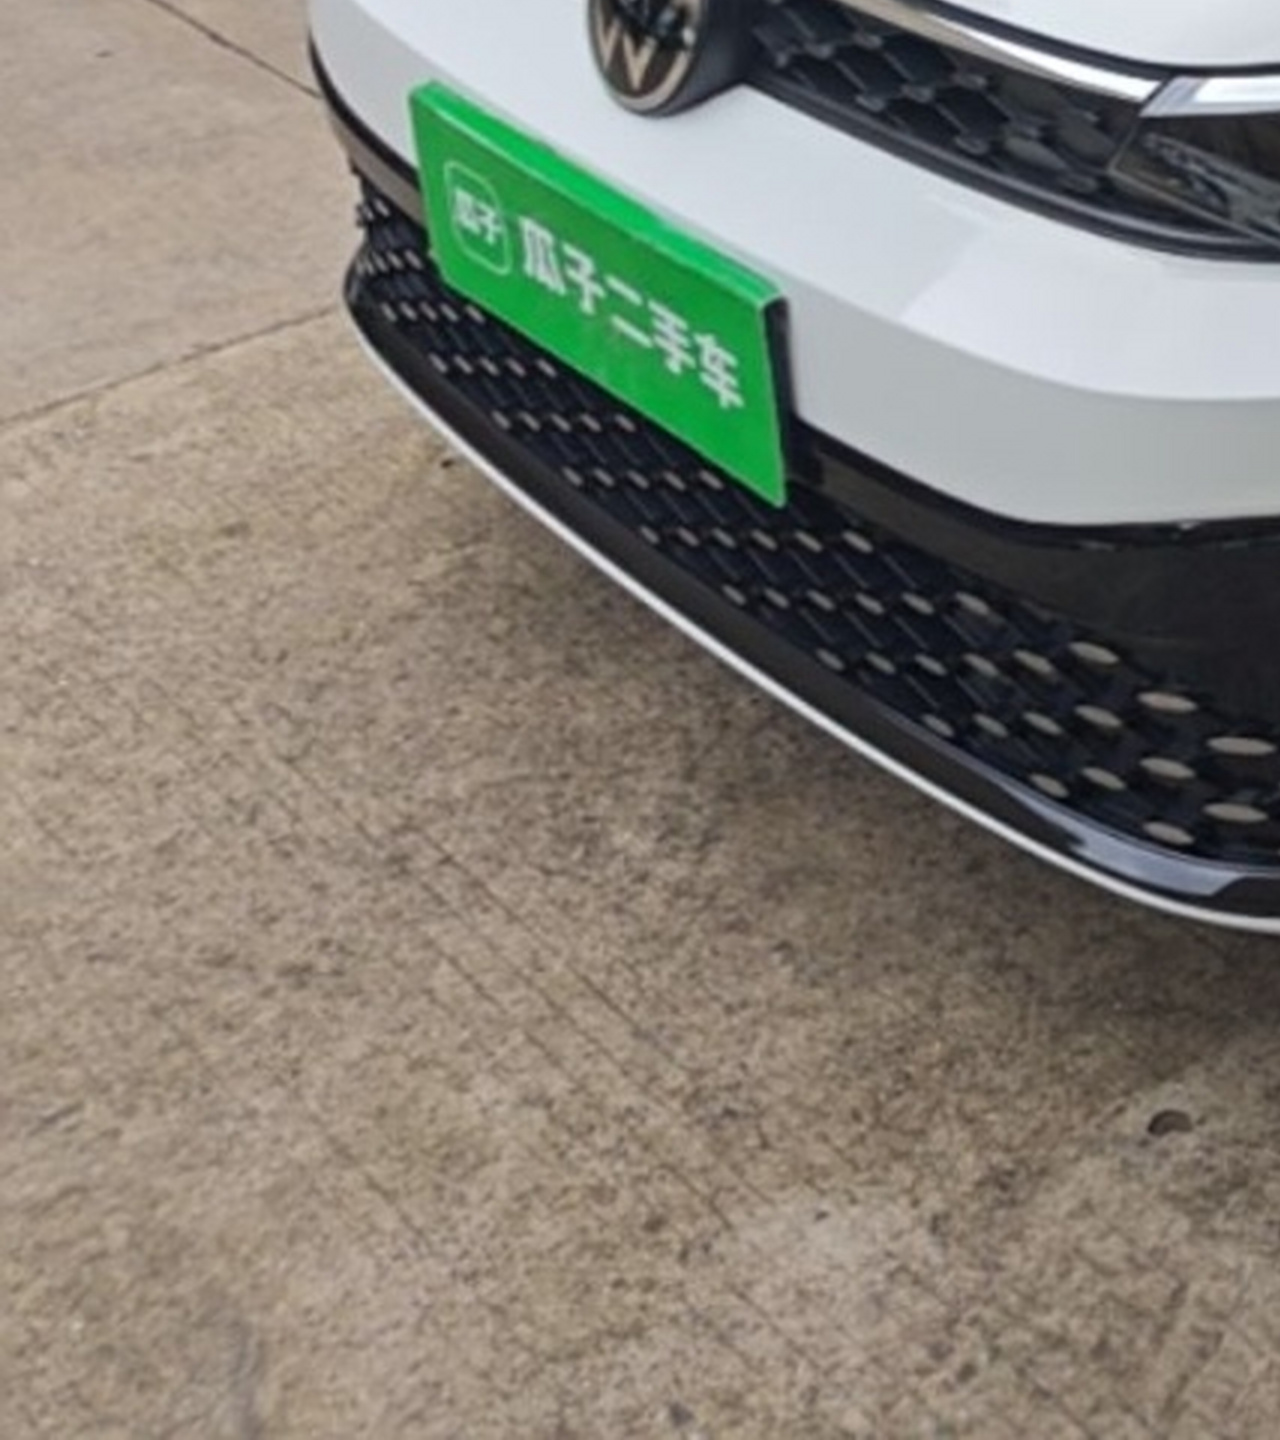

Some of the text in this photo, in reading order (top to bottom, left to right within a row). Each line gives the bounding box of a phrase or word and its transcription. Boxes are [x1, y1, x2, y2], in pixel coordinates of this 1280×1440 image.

[518, 215, 744, 411] 瓜子二手车
